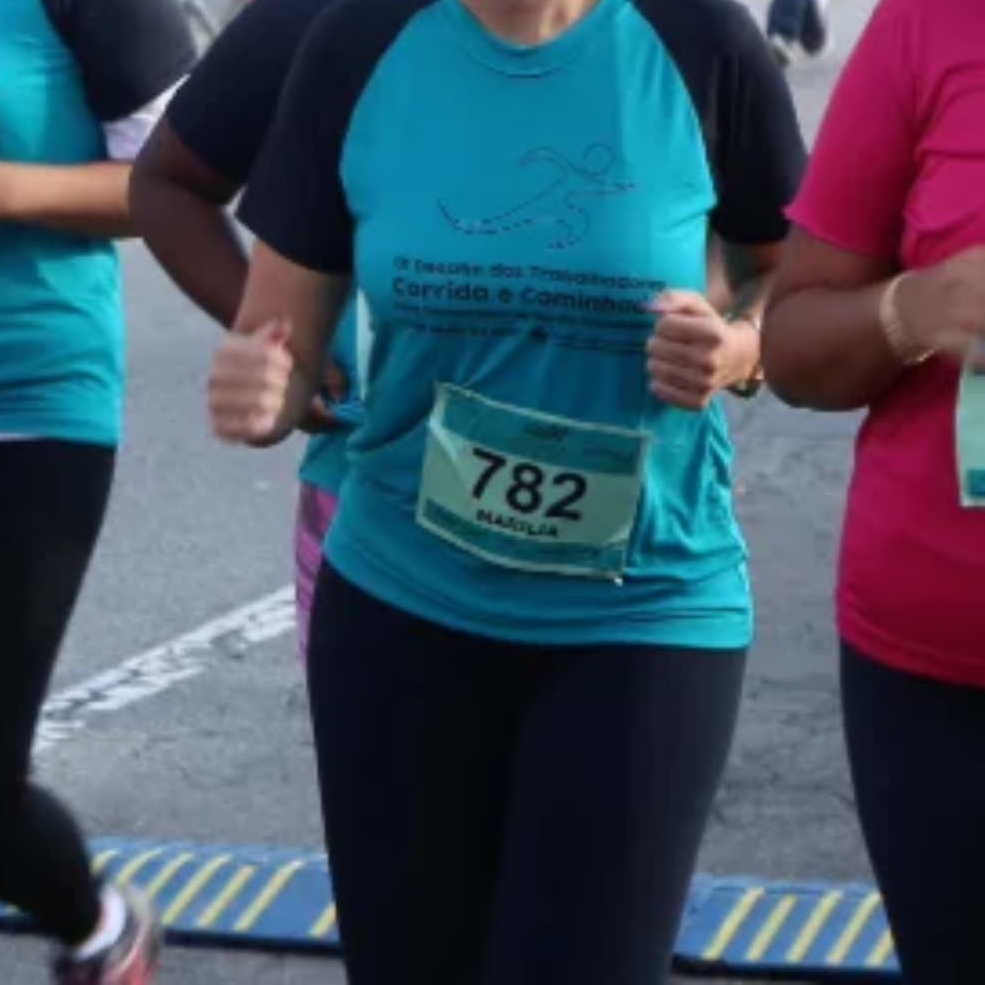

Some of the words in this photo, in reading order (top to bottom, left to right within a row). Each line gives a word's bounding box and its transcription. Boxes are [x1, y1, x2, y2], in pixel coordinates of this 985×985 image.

[393, 276, 491, 302] Corrida
[498, 287, 514, 304] e
[520, 285, 657, 315] Caminhad
[471, 446, 588, 522] 782
